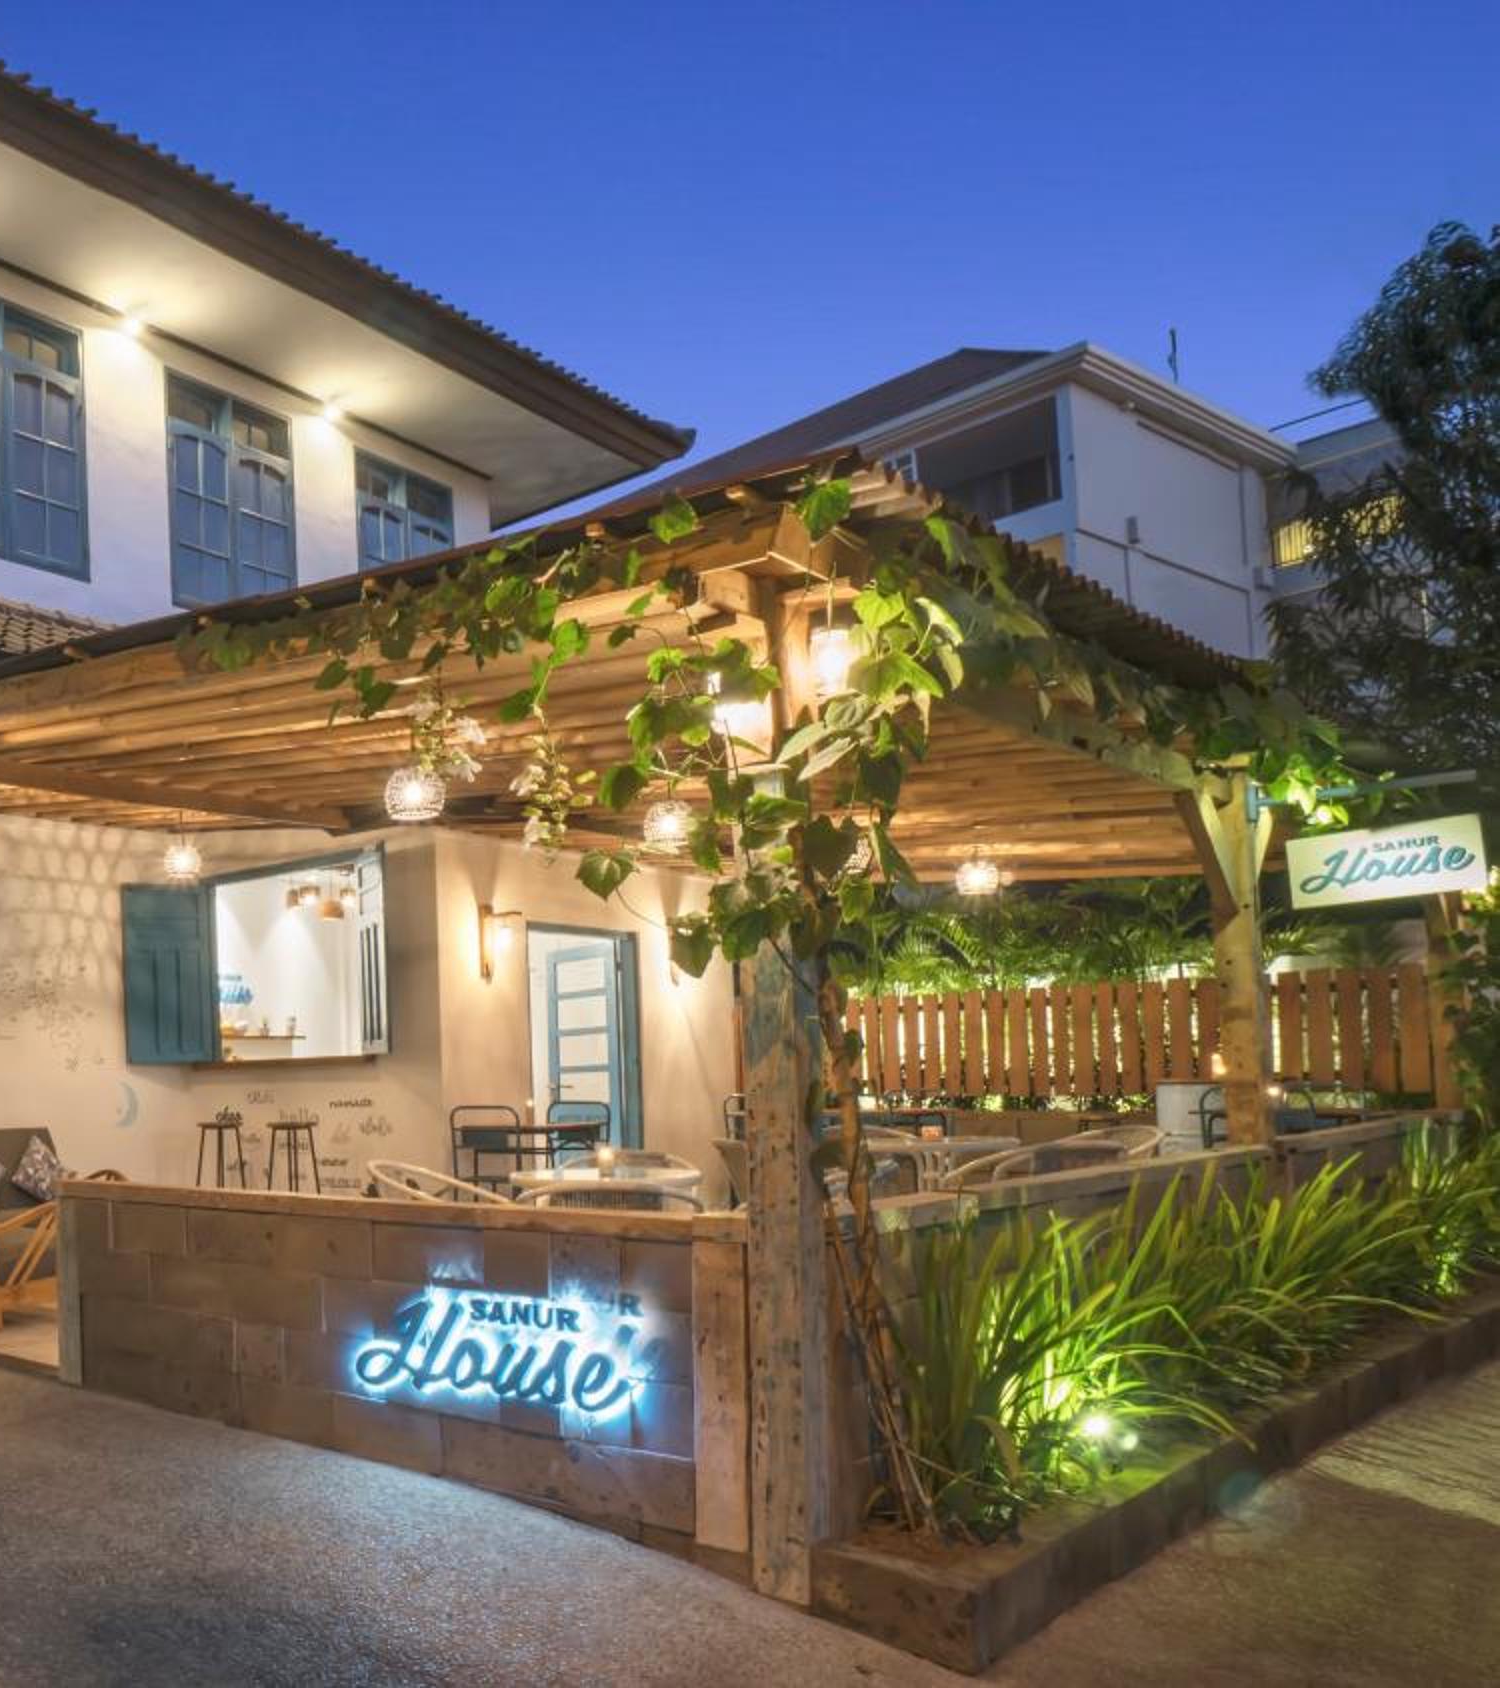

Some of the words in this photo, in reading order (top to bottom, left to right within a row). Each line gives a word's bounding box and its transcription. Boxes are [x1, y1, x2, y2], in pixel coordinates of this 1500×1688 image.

[1300, 846, 1476, 894] House
[469, 1298, 581, 1332] SANUR
[355, 1300, 632, 1411] House
